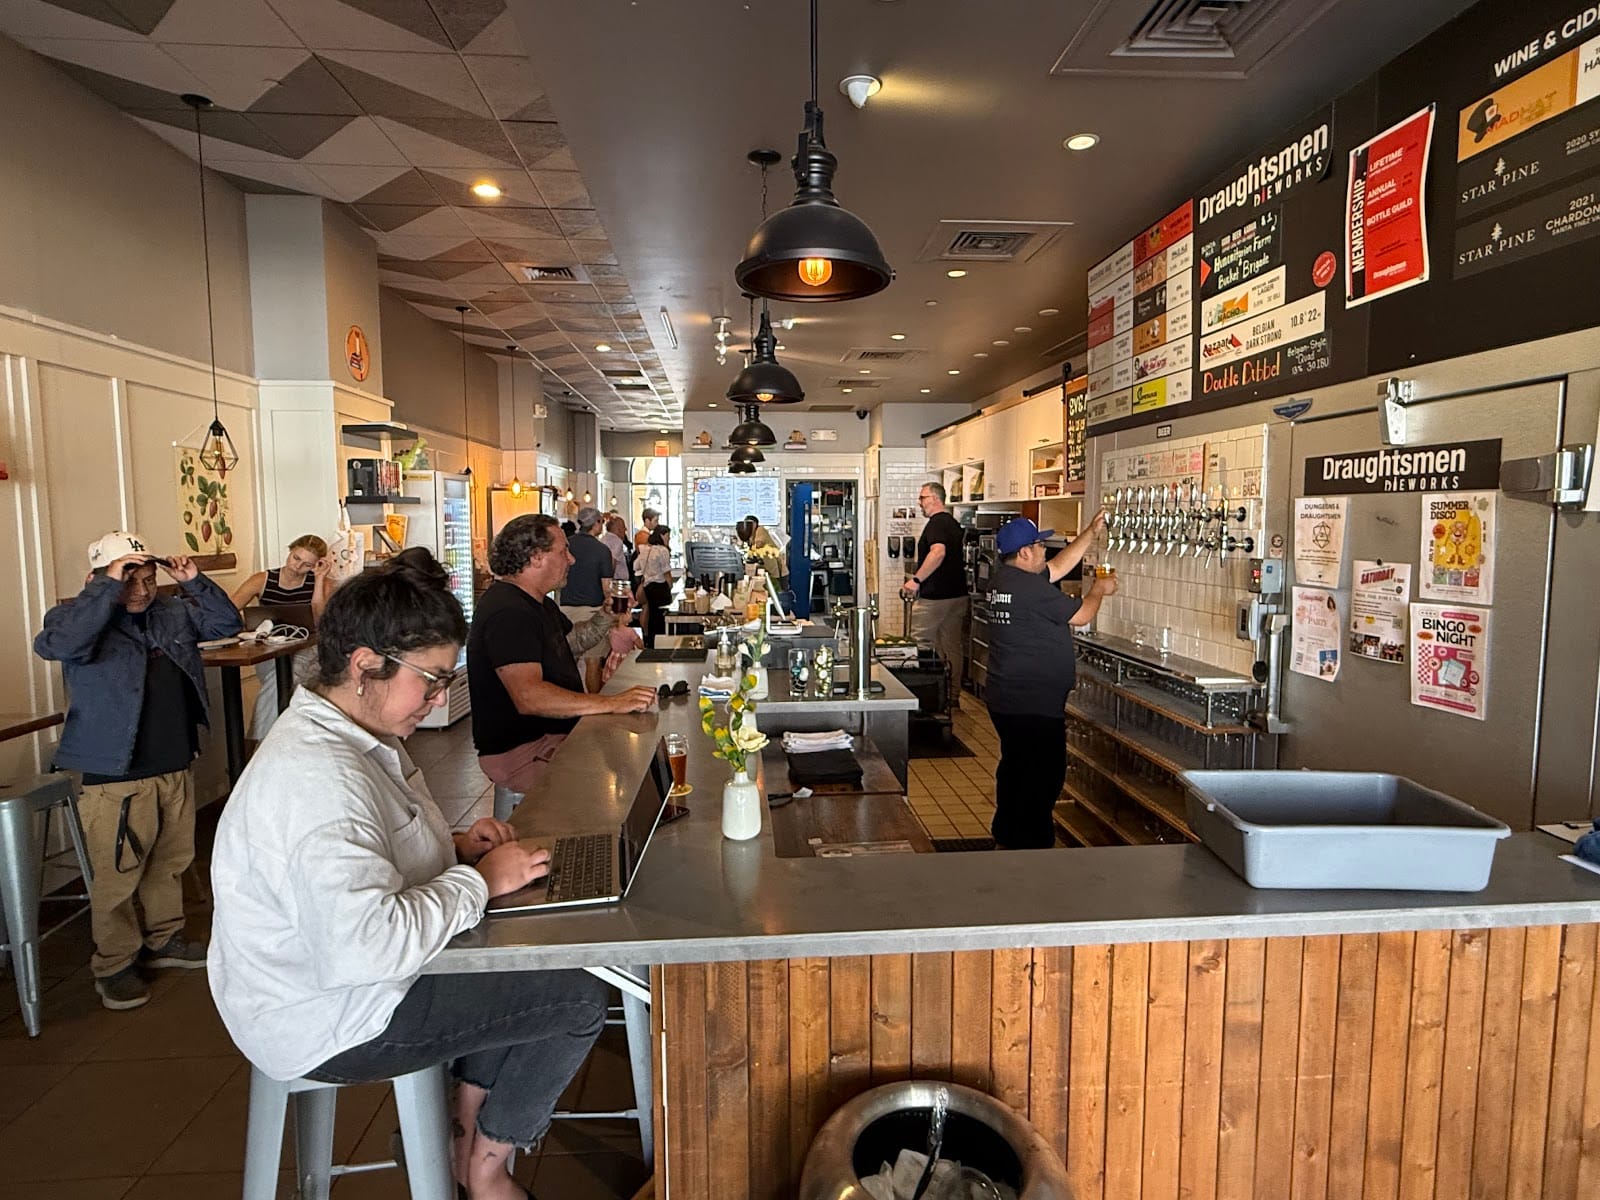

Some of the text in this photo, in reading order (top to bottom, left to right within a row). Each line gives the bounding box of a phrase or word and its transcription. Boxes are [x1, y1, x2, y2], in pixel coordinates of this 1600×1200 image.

[1494, 3, 1600, 78] WINE & CID
[1370, 147, 1403, 173] LIFETIME
[1199, 123, 1328, 224] Draughtsmen
[1461, 161, 1540, 203] STAR PINE
[1367, 178, 1397, 200] ANNUAL
[1366, 207, 1391, 227] BOTTLE
[1391, 197, 1413, 214] GUILD
[1569, 193, 1595, 211] 2021
[1459, 229, 1536, 265] STAR PINE
[1252, 320, 1275, 337] BELGIAN
[1246, 329, 1282, 350] DARK STRONG
[1323, 448, 1466, 484] Draughtsmen
[1430, 501, 1470, 511] SUMMER
[1430, 511, 1457, 520] DISCO
[127, 537, 145, 552] LA
[1422, 618, 1466, 634] BINGO
[1436, 632, 1476, 647] NIGHT
